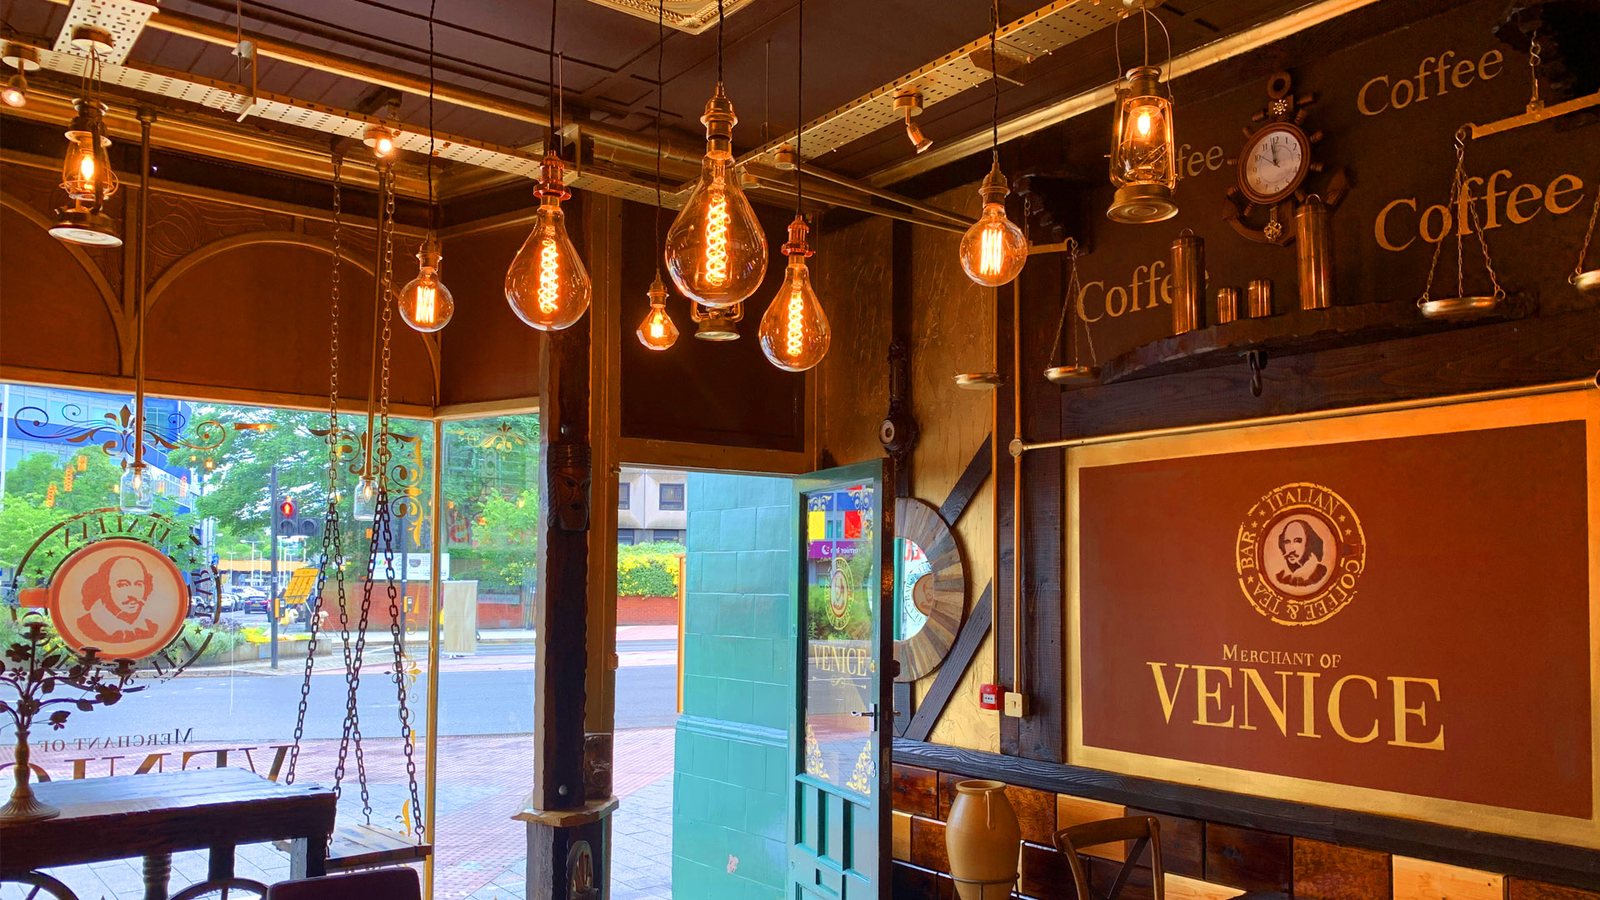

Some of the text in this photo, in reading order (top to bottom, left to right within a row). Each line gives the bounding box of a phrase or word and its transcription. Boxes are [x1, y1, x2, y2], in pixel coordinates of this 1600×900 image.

[1357, 50, 1503, 116] Coffee
[1272, 136, 1279, 145] 12
[1175, 143, 1225, 182] fee
[1374, 169, 1585, 252] Coffee
[1077, 260, 1210, 323] Coffe
[1267, 488, 1341, 516] ITALIAN
[1240, 531, 1257, 570] BAR
[1253, 559, 1361, 620] COFFEE & TEA
[814, 644, 867, 676] VENICE
[1320, 653, 1342, 669] OF
[1146, 661, 1445, 751] VENICE
